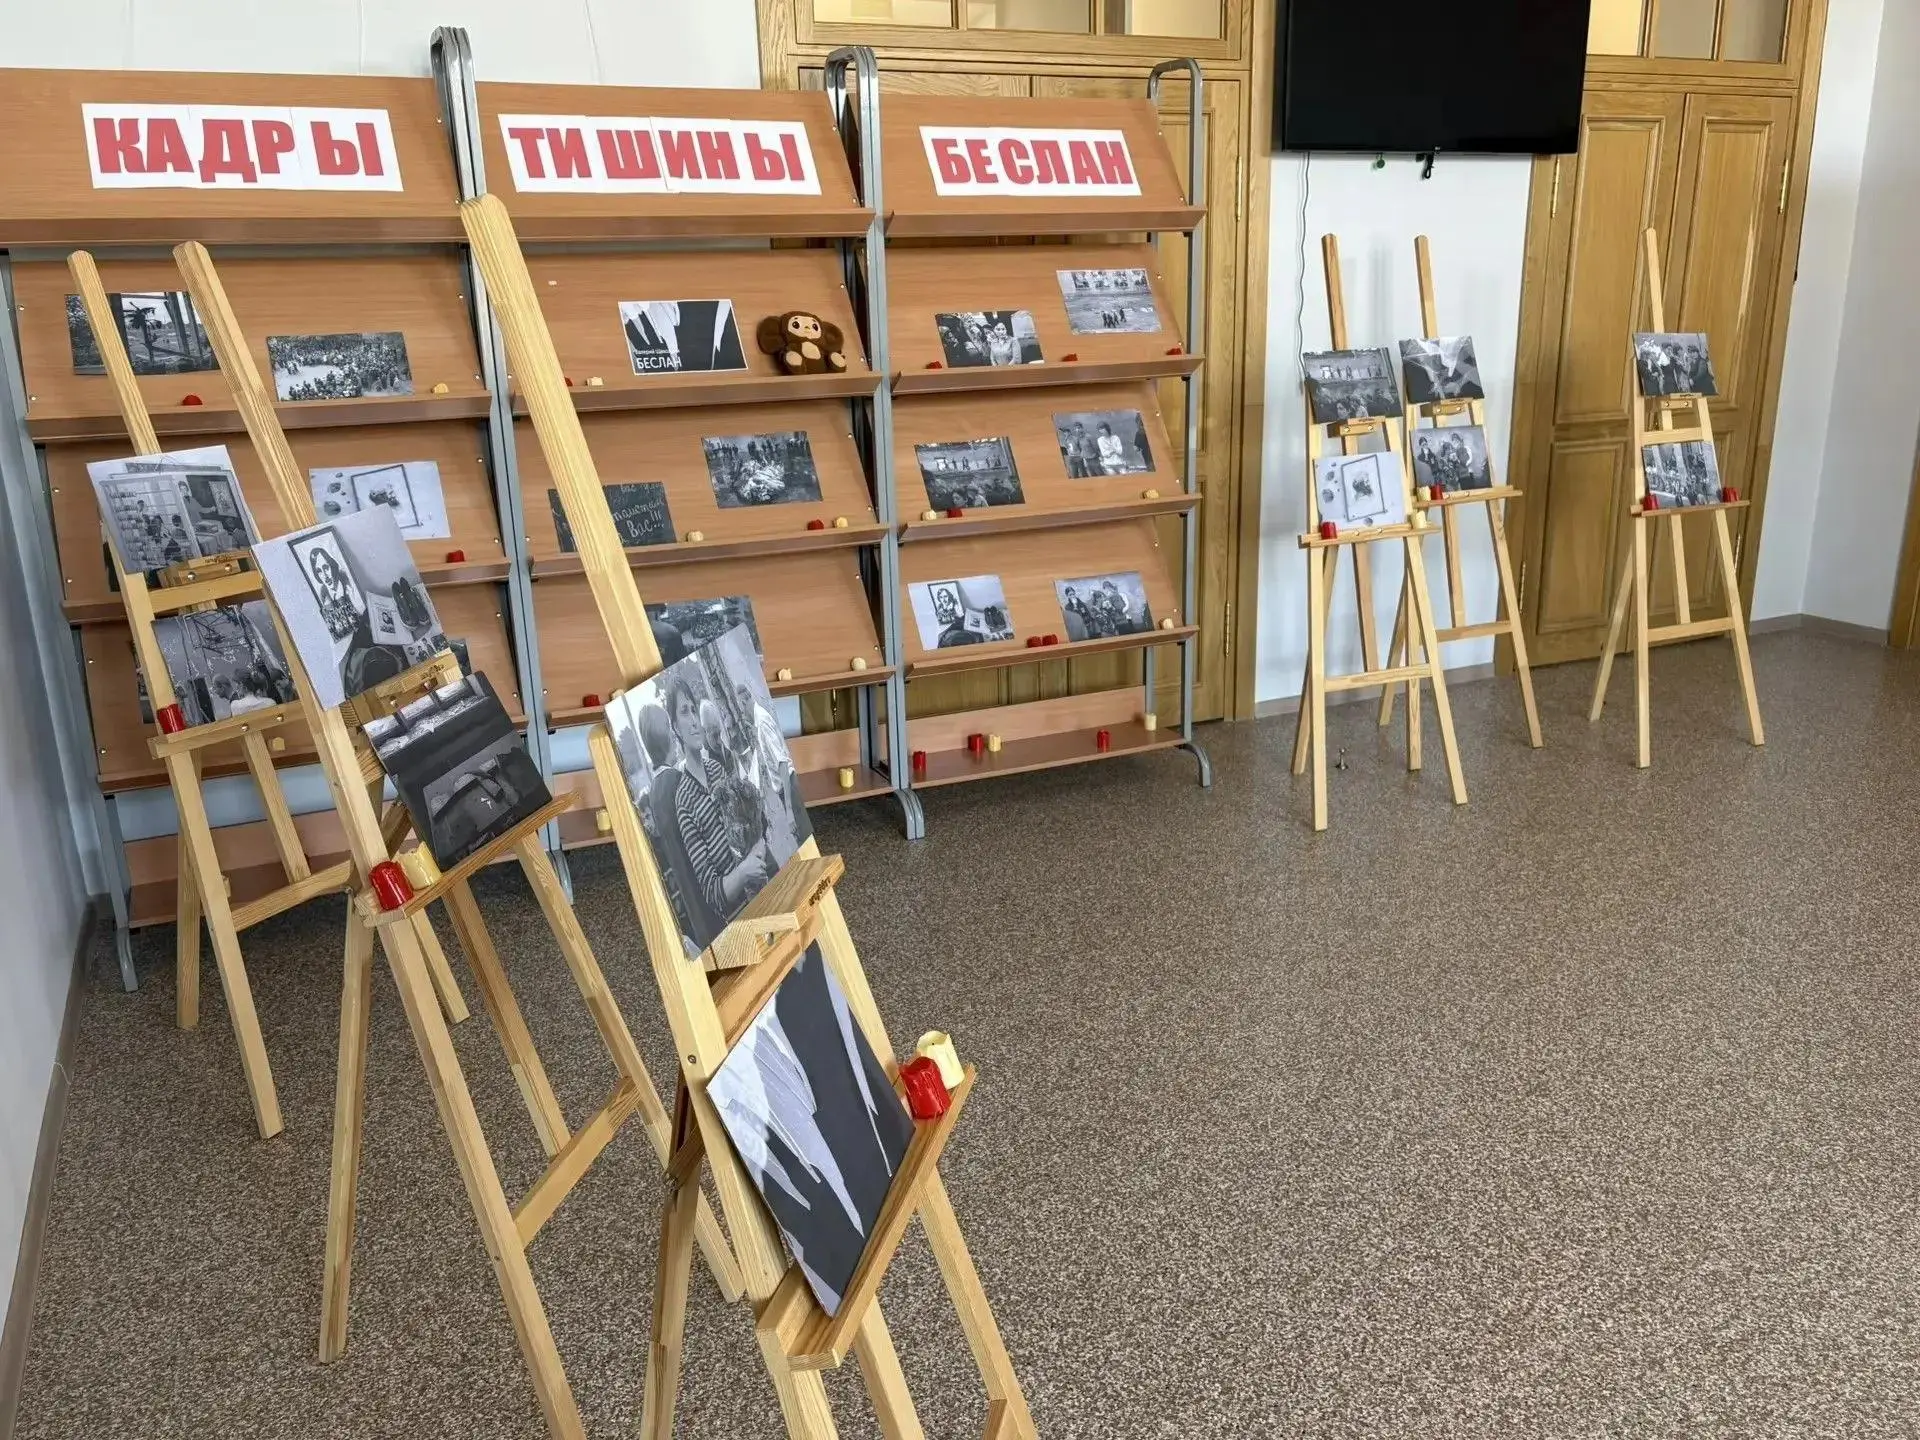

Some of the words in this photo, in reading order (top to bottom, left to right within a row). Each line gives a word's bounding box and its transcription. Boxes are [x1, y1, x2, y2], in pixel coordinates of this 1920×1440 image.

[92, 118, 385, 183] КАДРЫ
[508, 127, 805, 181] ТИШИНЫ
[931, 138, 1133, 185] БЕСЛАН
[636, 356, 682, 369] БЕСЛАН
